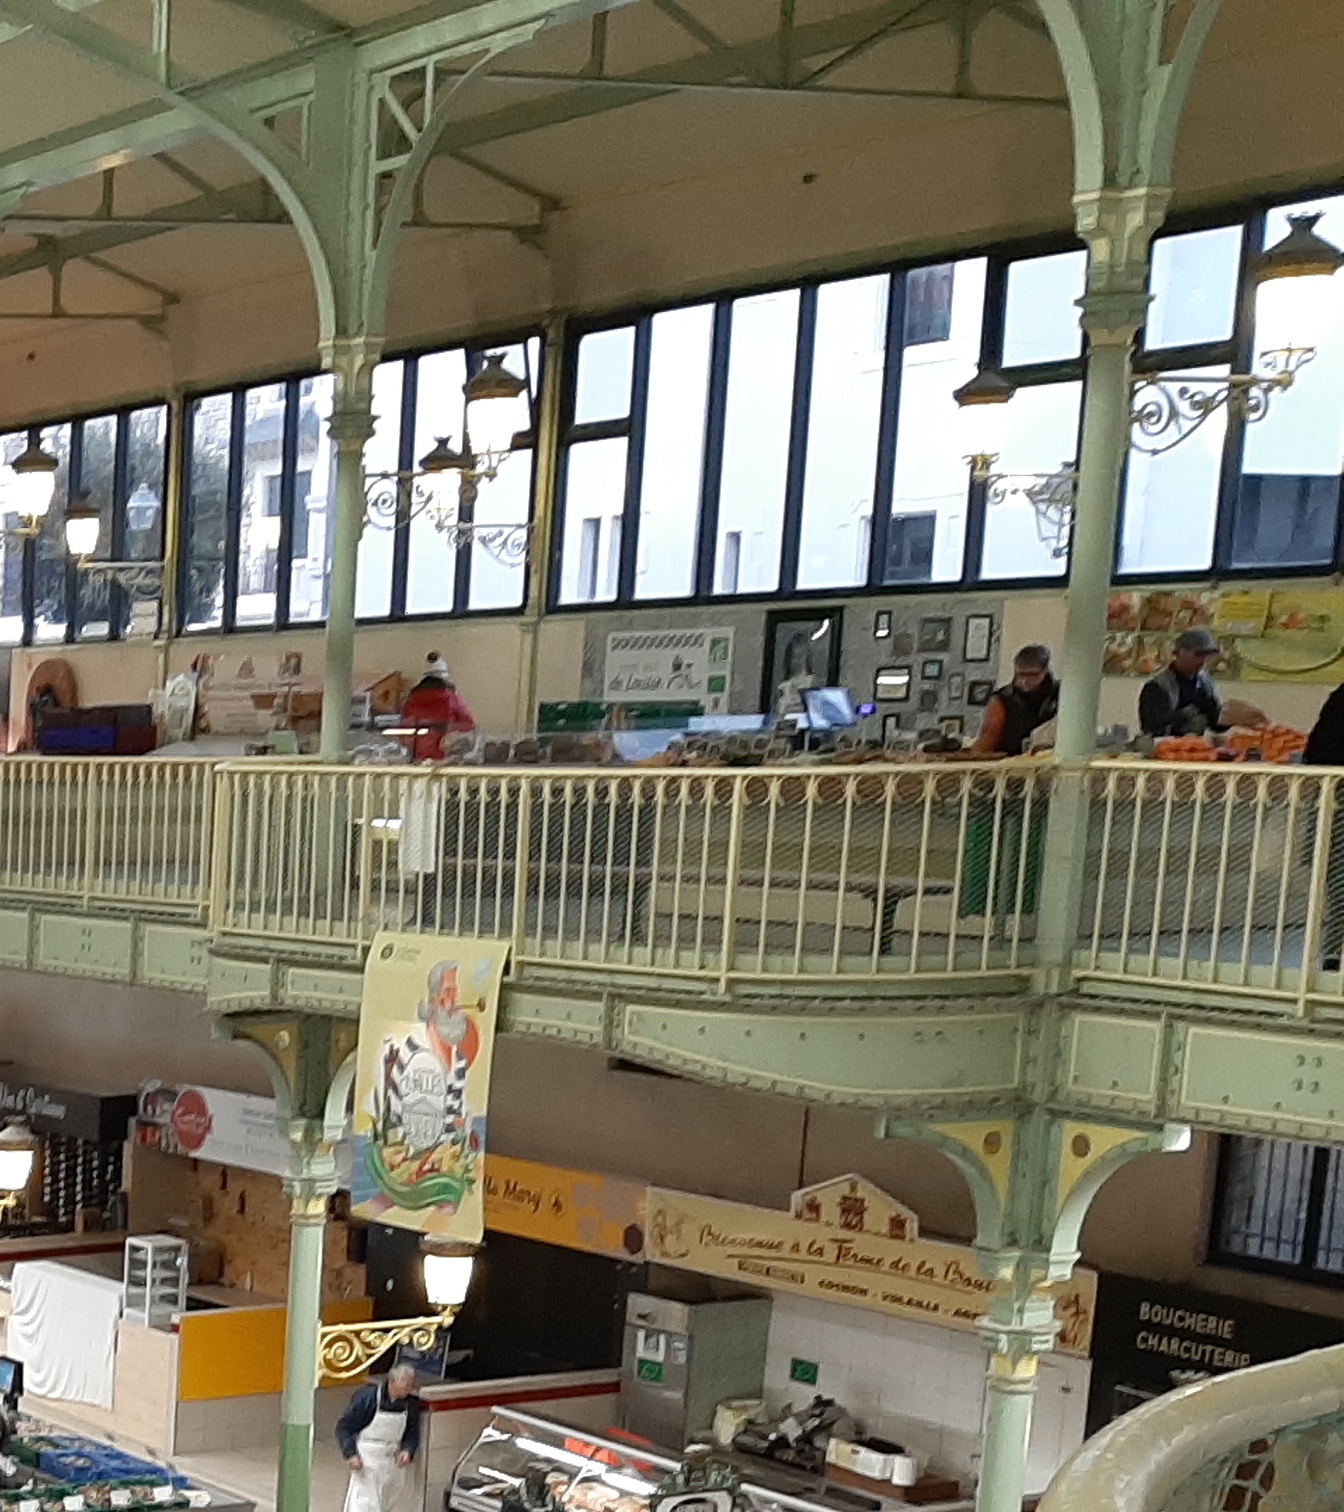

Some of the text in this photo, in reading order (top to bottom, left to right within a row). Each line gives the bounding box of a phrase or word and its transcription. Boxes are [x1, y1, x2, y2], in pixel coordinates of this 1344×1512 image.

[808, 1239, 825, 1258] la
[890, 1255, 911, 1274] de
[915, 1260, 937, 1279] la
[1138, 1301, 1235, 1340] BOUCHERIE
